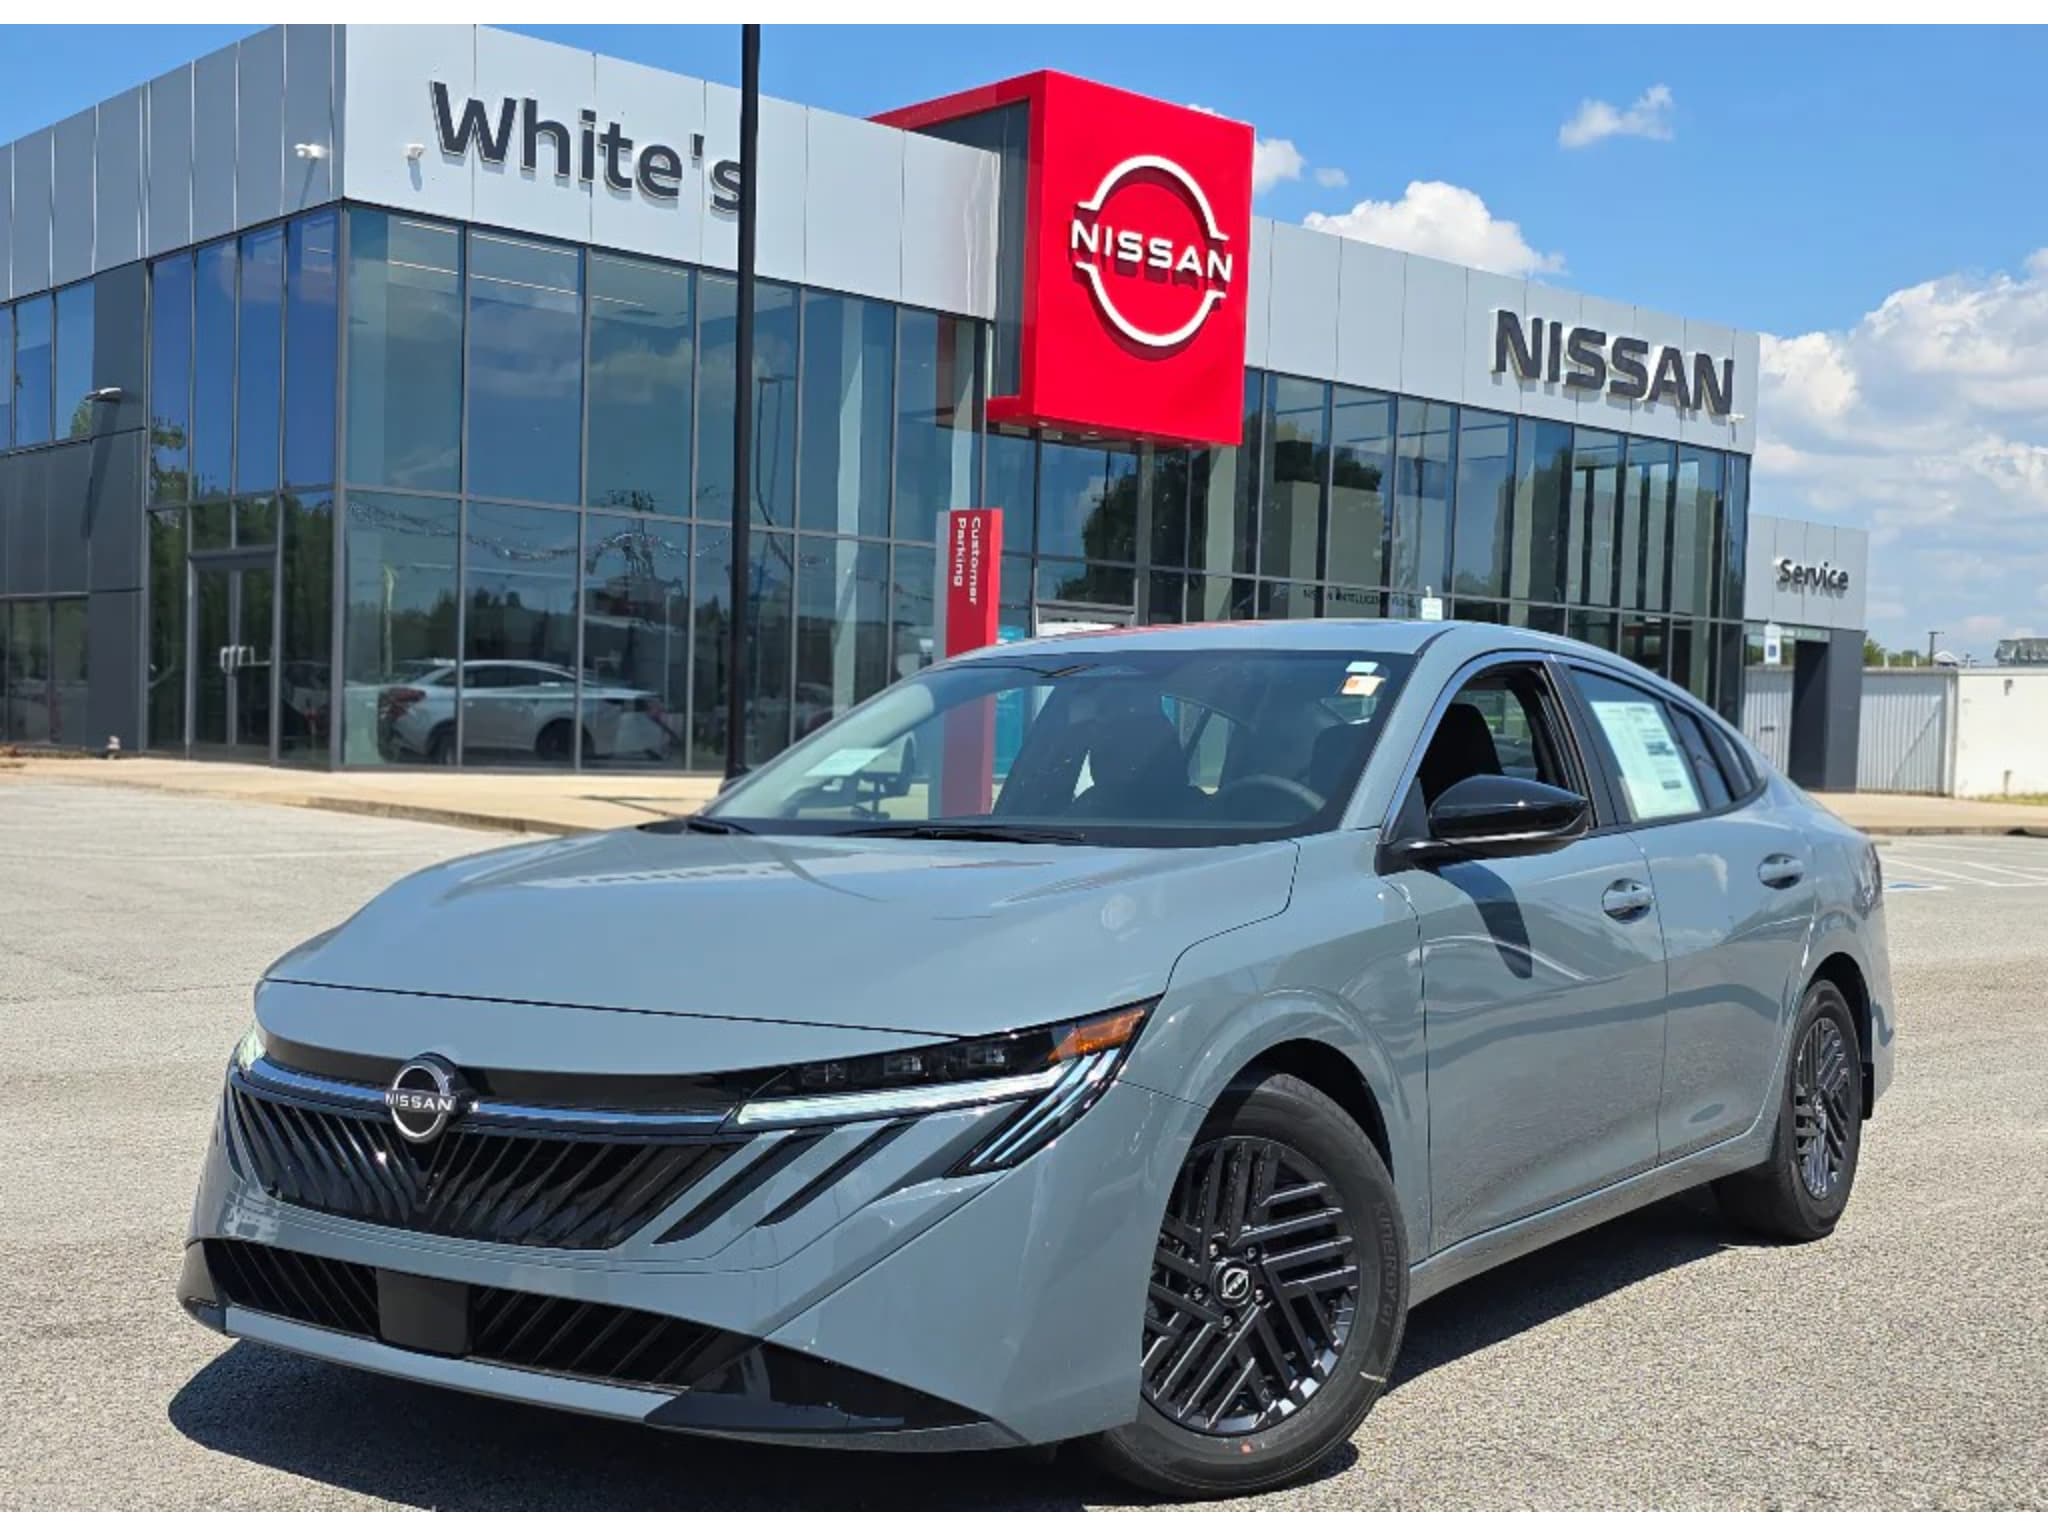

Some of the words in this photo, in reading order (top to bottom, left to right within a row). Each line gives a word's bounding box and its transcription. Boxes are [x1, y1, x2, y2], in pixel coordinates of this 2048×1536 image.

[430, 80, 742, 213] White's
[1071, 219, 1233, 283] NISSAN
[1494, 308, 1735, 416] NISSAN
[953, 517, 967, 587] Parking
[969, 516, 981, 606] Customer
[1778, 559, 1849, 591] Service
[385, 1092, 453, 1112] NISSAN
